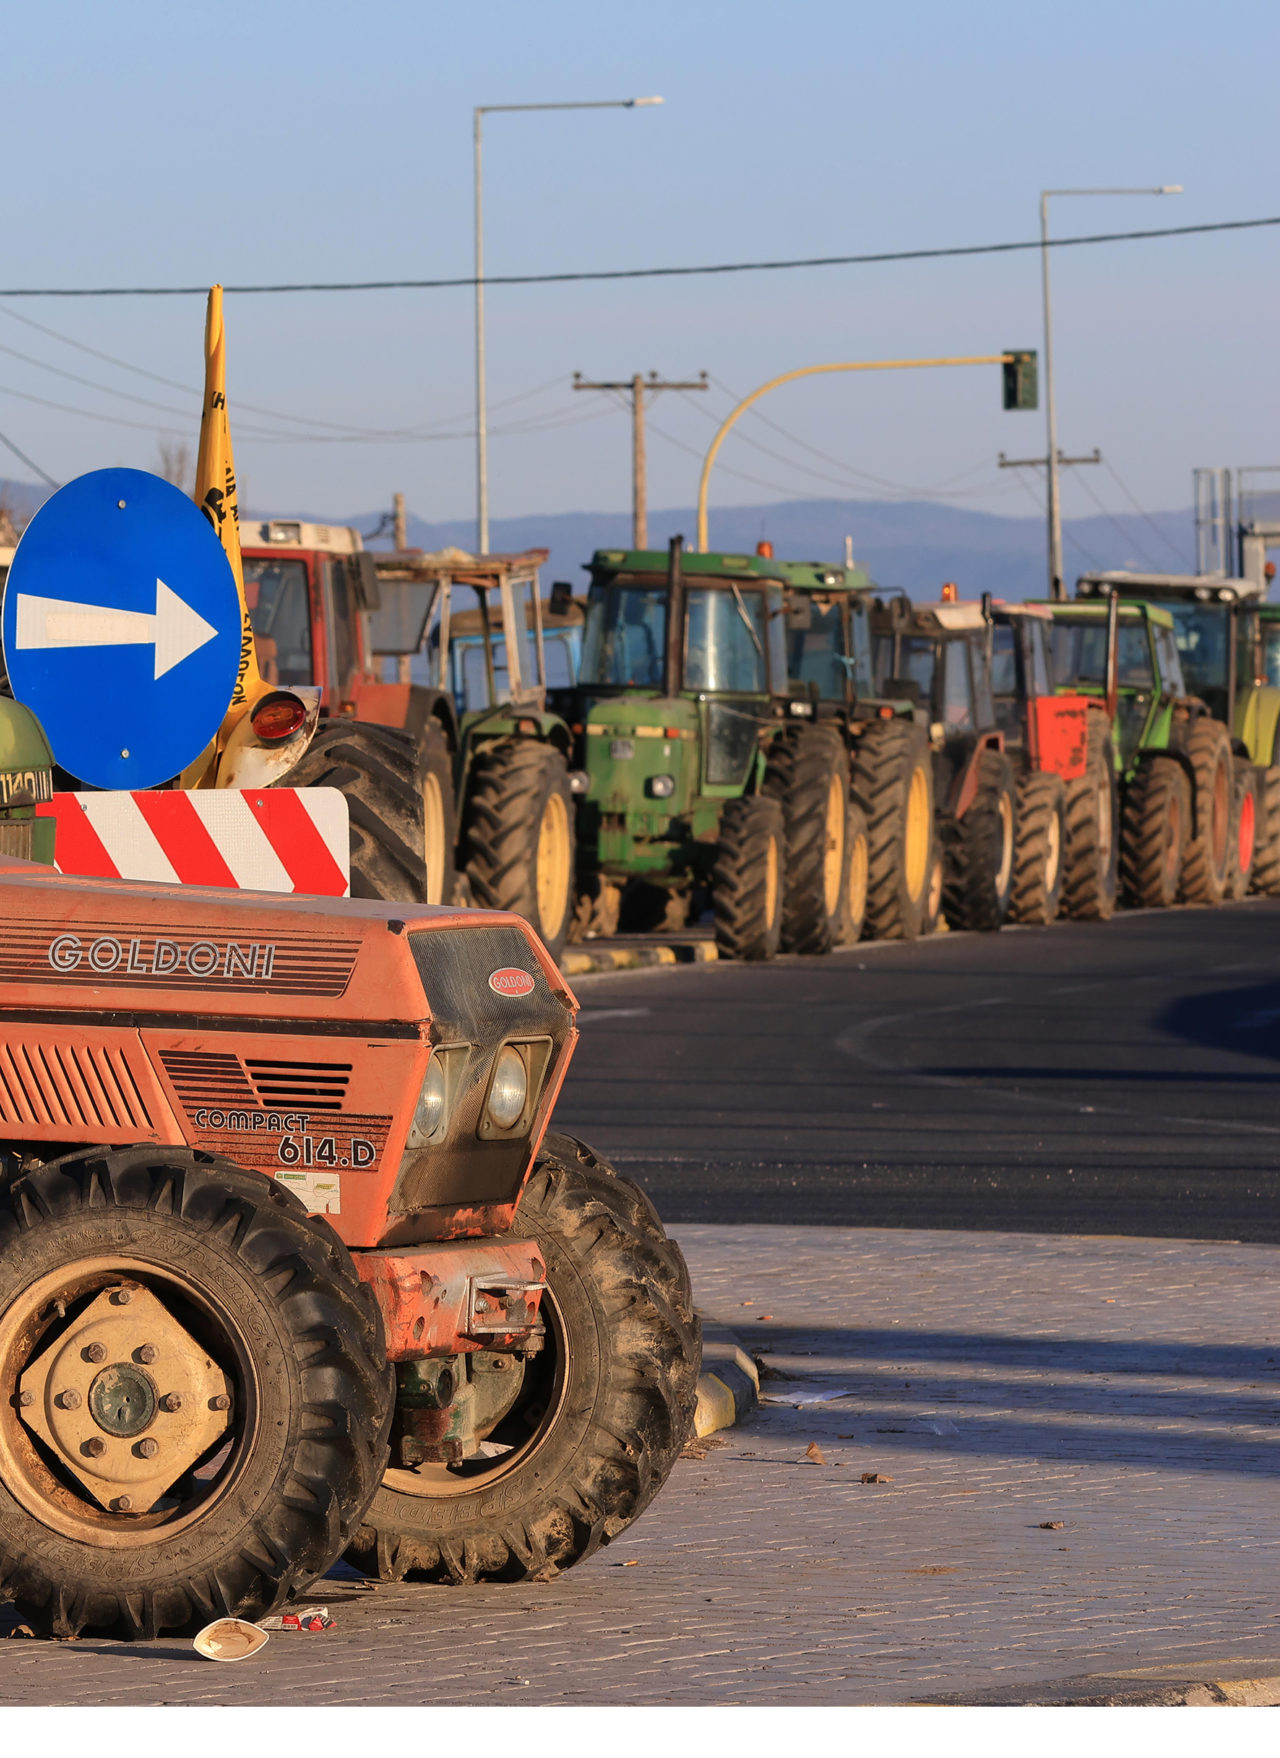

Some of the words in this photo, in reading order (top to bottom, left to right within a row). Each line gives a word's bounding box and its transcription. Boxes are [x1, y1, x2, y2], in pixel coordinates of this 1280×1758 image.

[0, 771, 37, 804] 1140
[48, 934, 276, 979] GOLDONI
[492, 975, 532, 989] GOLDONI
[195, 1109, 310, 1133] COMPACT
[278, 1135, 377, 1168] 614.D
[207, 1265, 270, 1338] KING
